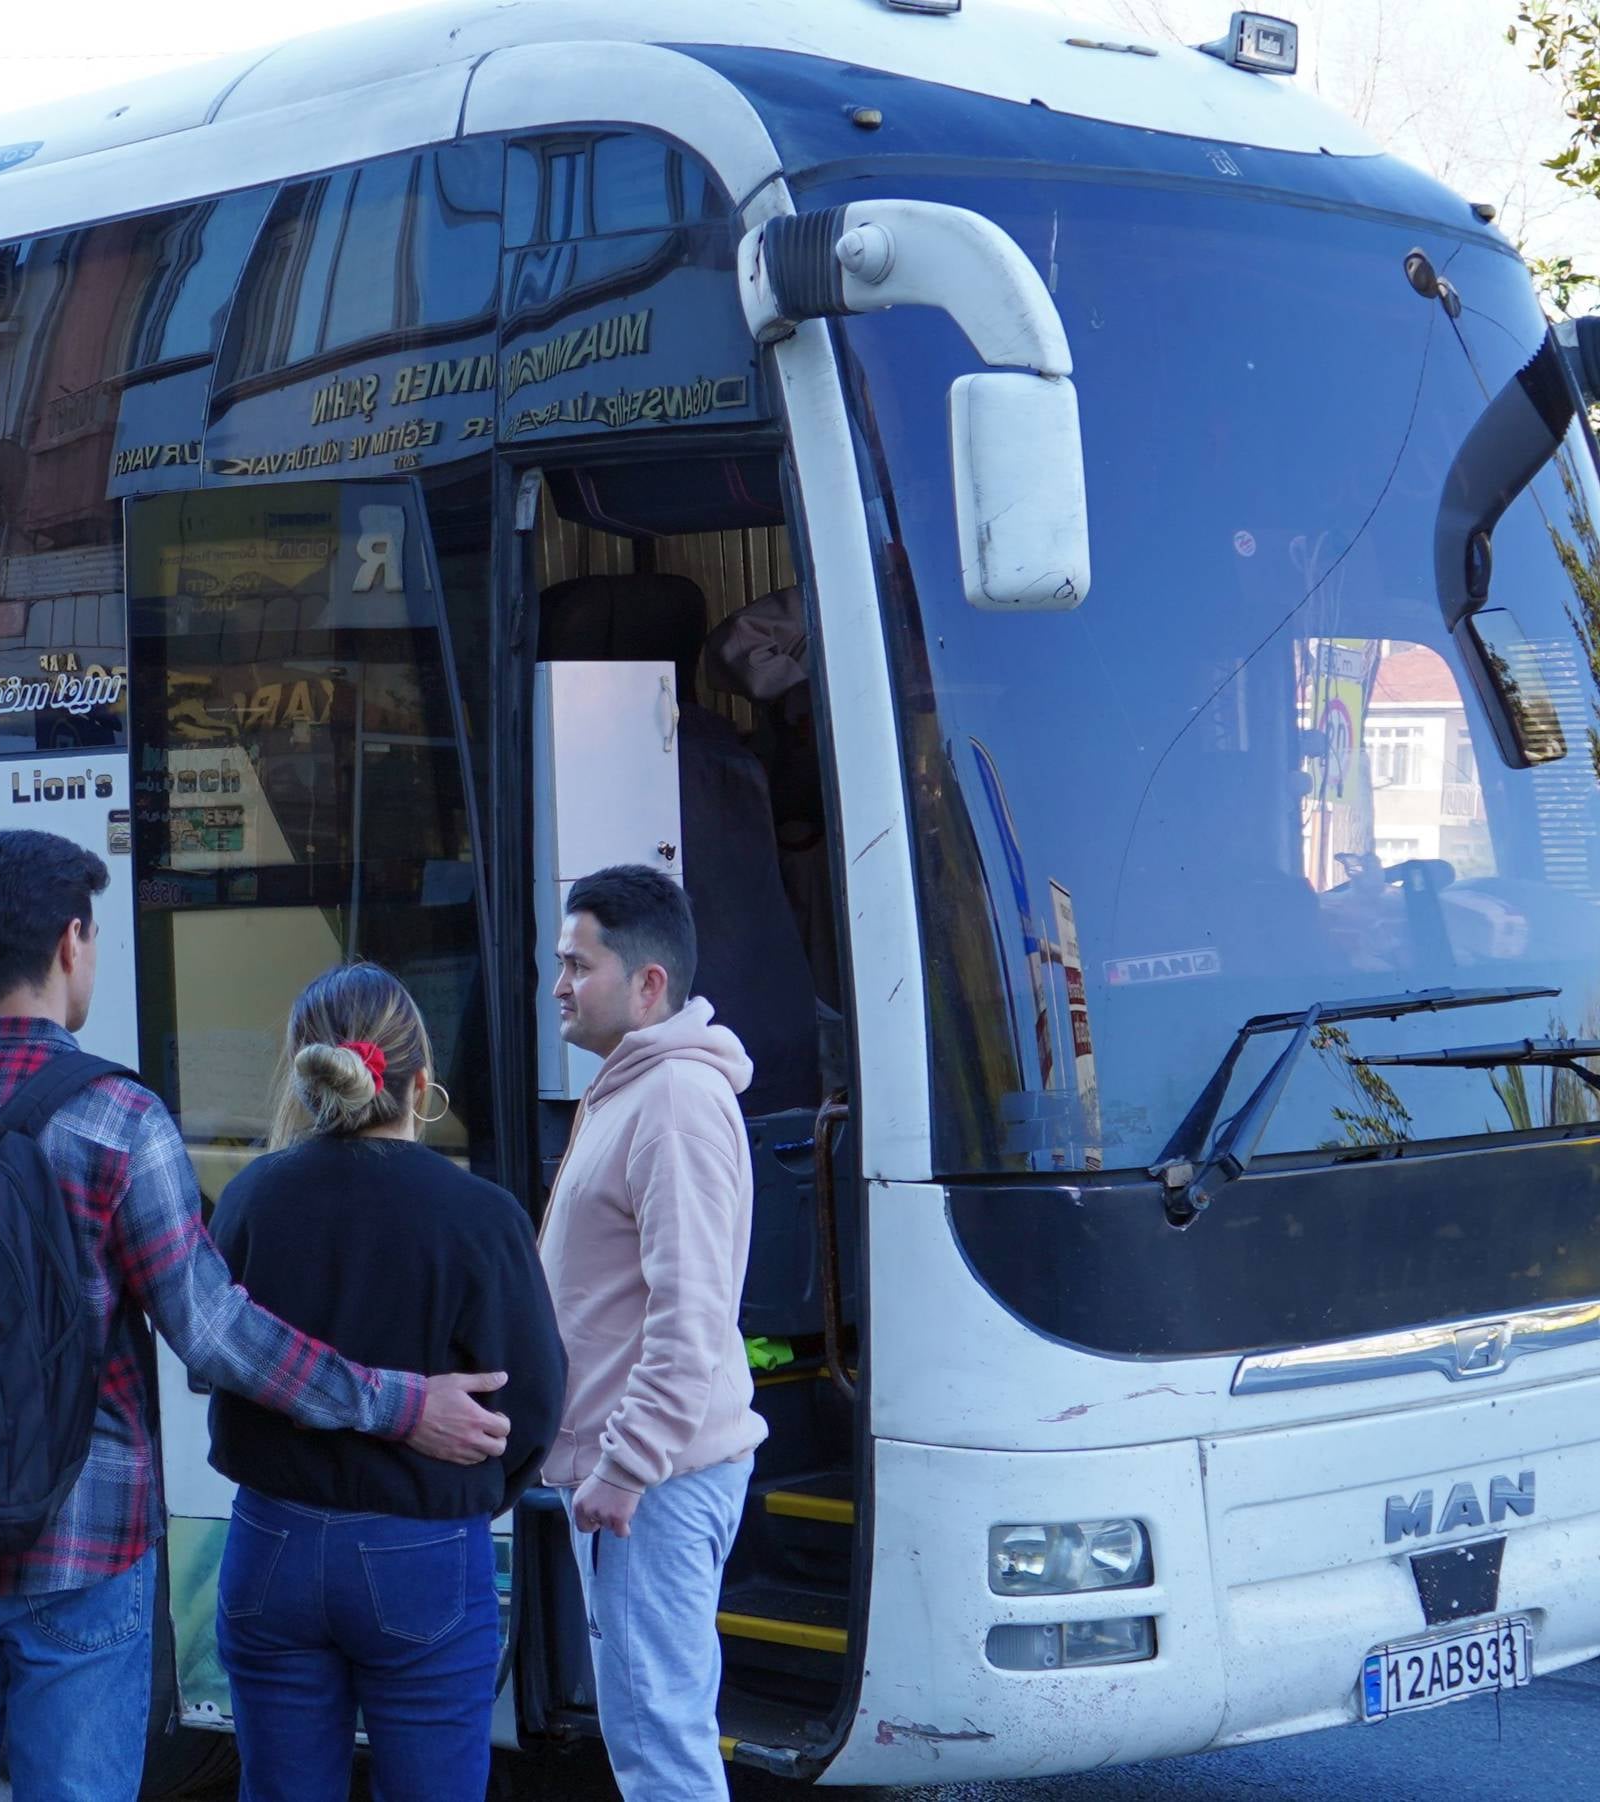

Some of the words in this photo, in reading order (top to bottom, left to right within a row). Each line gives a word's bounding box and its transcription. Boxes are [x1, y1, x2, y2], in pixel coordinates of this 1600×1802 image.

[11, 769, 113, 804] Lion's
[1385, 1471, 1536, 1544] MAN
[1387, 1632, 1517, 1704] 12AB933
